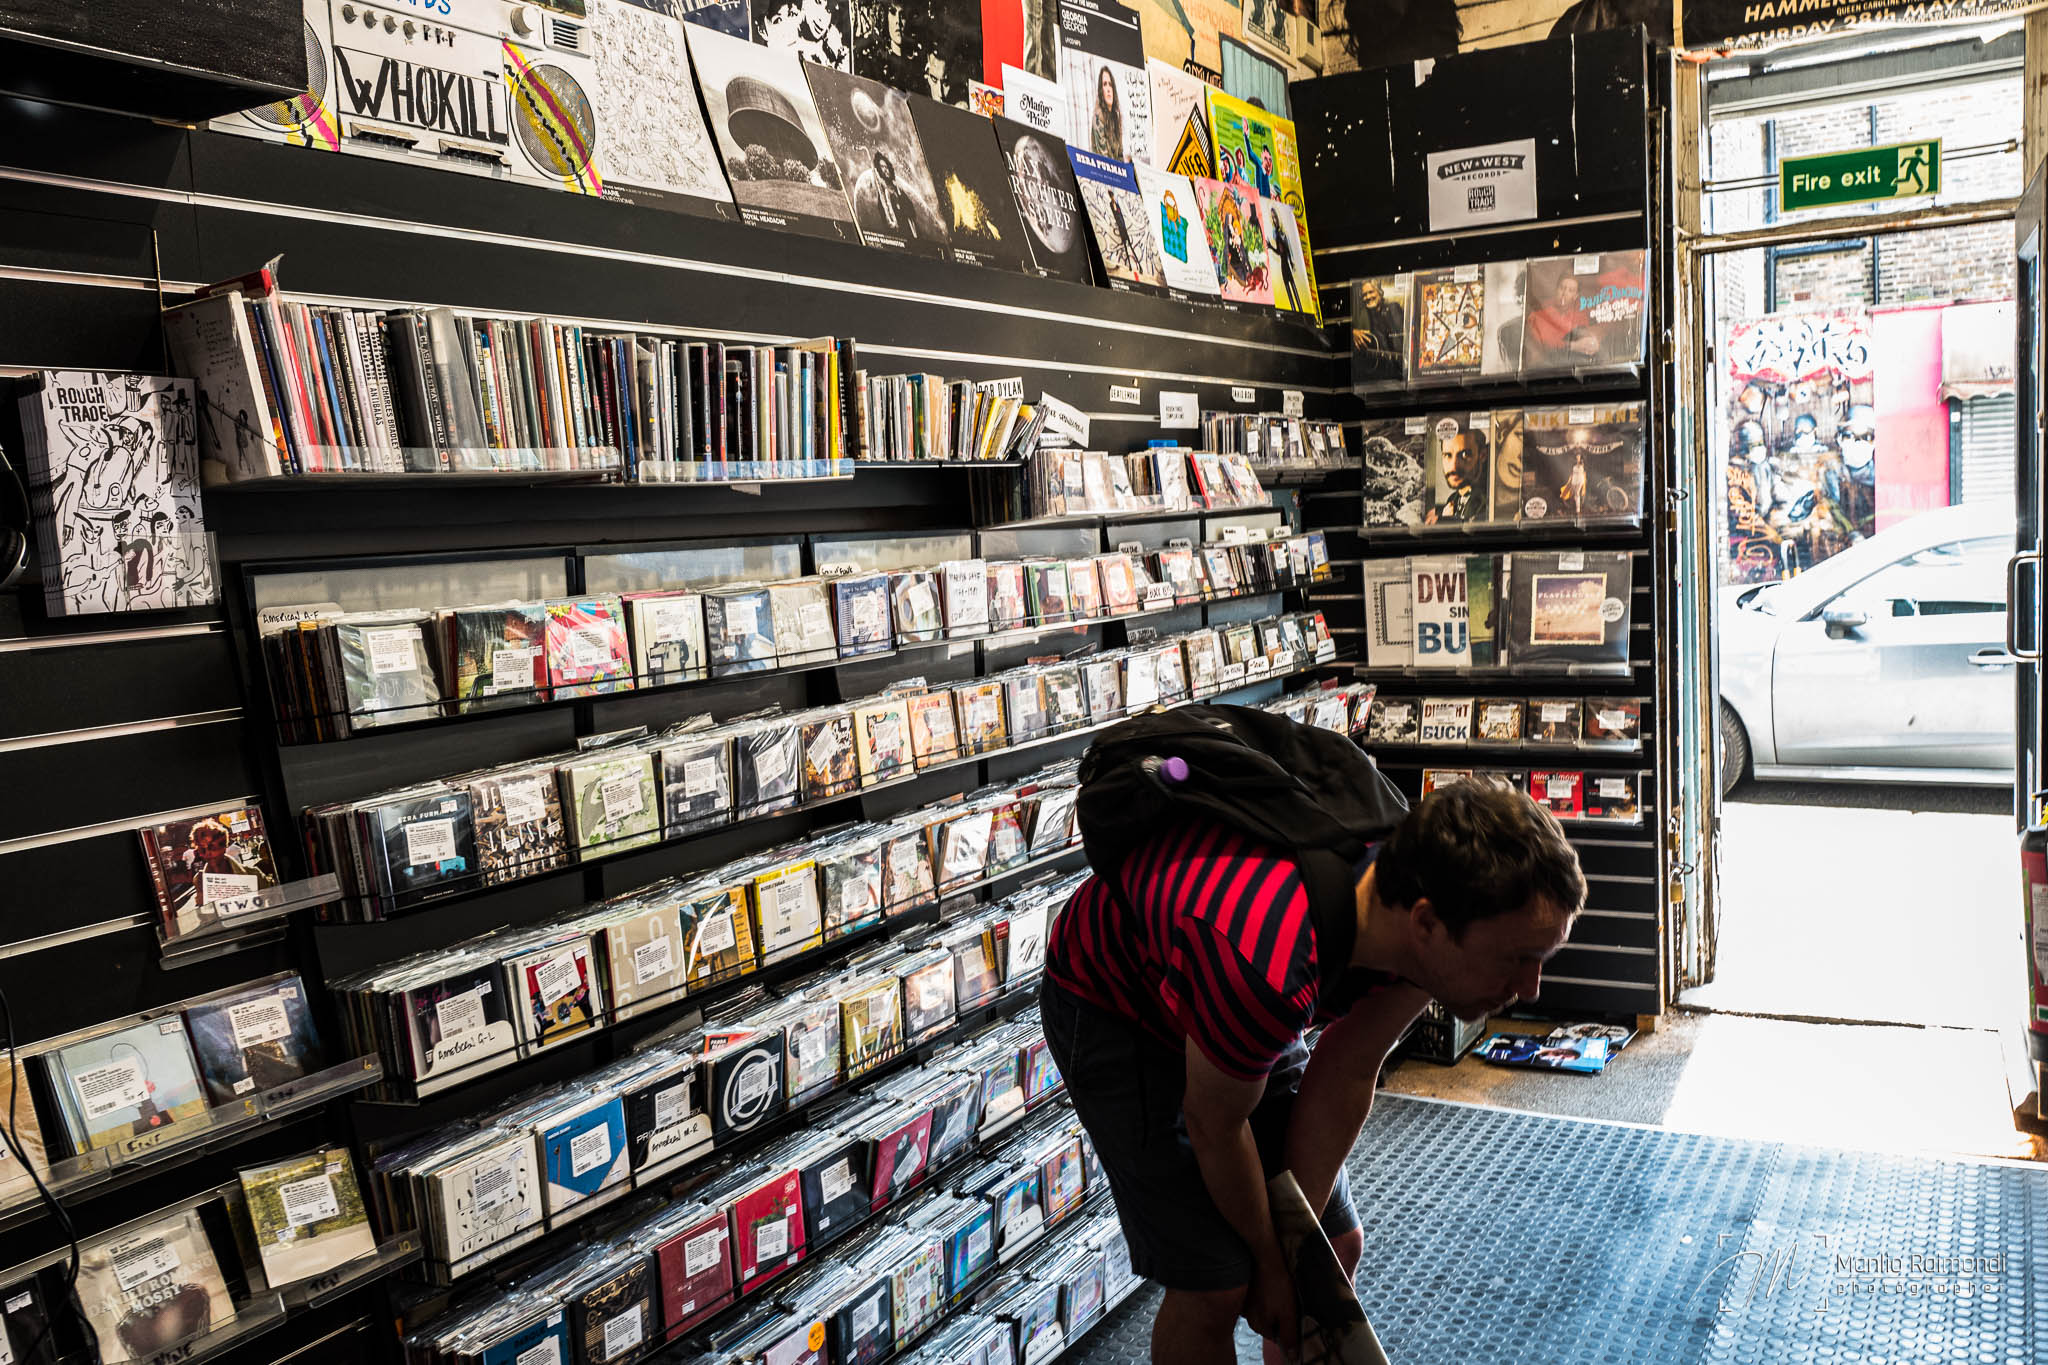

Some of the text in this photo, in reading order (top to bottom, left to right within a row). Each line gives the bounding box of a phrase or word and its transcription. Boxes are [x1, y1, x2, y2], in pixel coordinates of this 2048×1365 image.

[1061, 9, 1088, 26] GEORGIA
[1837, 5, 1861, 16] QUEEN
[1063, 20, 1088, 35] GEORGIA
[335, 46, 508, 145] WHOKILL
[1020, 93, 1053, 118] Margo
[1026, 110, 1050, 128] Price
[1006, 151, 1041, 181] MAX
[1444, 156, 1518, 176] NEW WEST
[1461, 171, 1501, 181] RECORDS
[1793, 167, 1881, 193] Fire exit
[1011, 175, 1076, 212] RICHTER
[1468, 185, 1494, 198] ROUGH
[1469, 198, 1494, 210] TRADE
[1028, 201, 1070, 230] SLEEP
[57, 387, 104, 405] ROUGH
[419, 334, 431, 364] CLASH
[434, 414, 445, 443] WORLD
[997, 381, 1022, 397] DYLAN
[60, 405, 108, 422] TRADE
[368, 387, 383, 425] ANTIBALAS
[380, 385, 393, 417] CHARLES
[387, 418, 400, 450] BRADLEY
[1527, 408, 1640, 427] NIK LANE
[1417, 572, 1466, 604] DWI
[263, 610, 319, 623] AMERICAN A-F
[1449, 607, 1470, 618] SIN
[1418, 621, 1467, 654] BU
[1423, 726, 1467, 740] BUCK
[398, 809, 442, 824] EZRA FURM
[219, 896, 264, 913] TWO
[478, 1033, 495, 1044] G-L
